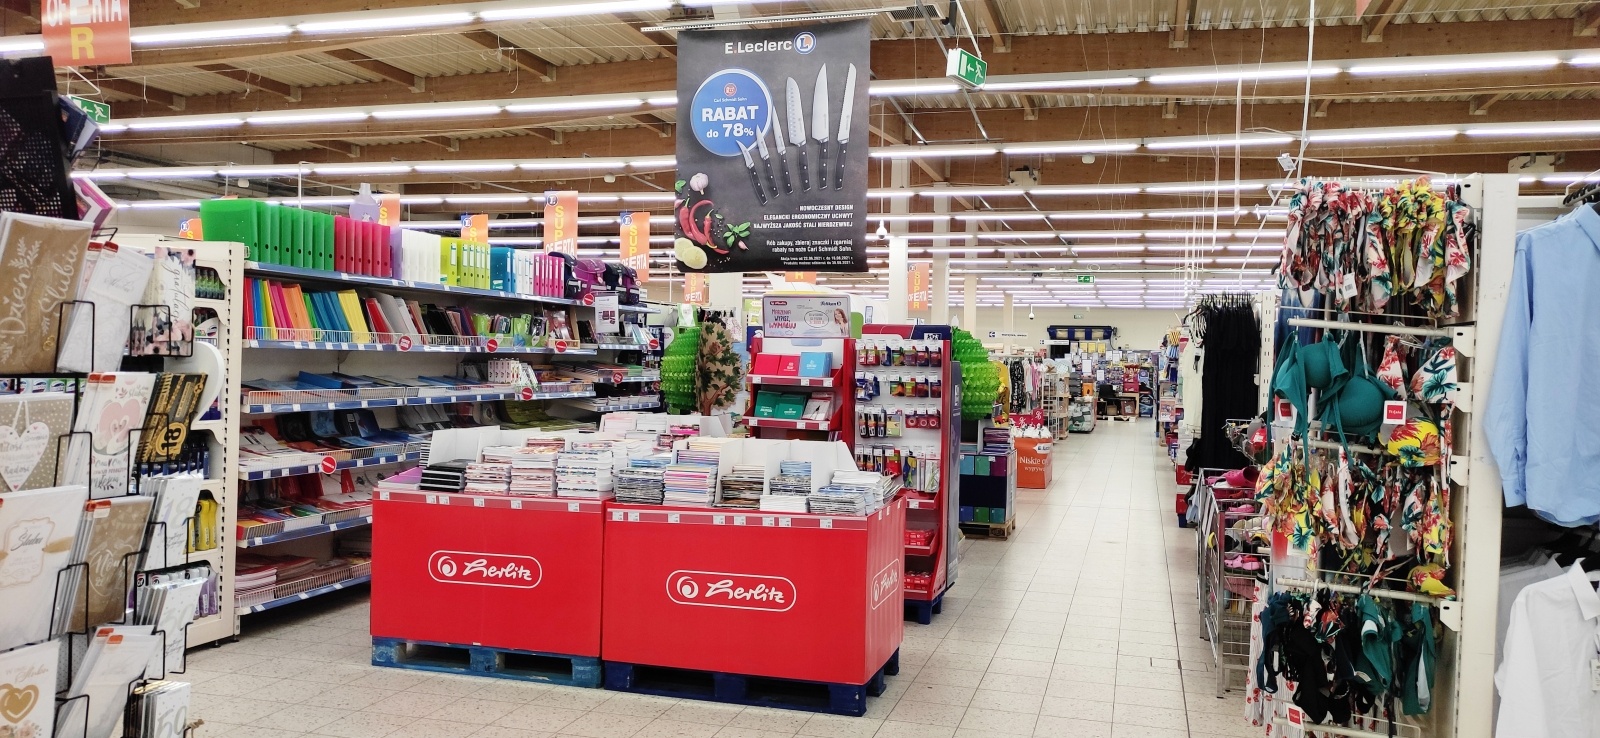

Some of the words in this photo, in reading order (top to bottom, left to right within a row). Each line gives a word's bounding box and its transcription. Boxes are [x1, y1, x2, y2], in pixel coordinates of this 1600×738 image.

[724, 39, 793, 54] E.Leclerc
[702, 105, 759, 122] RABAT
[706, 129, 719, 138] do
[722, 122, 754, 138] 78%
[753, 221, 782, 229] NAJWYŻSZA
[1019, 456, 1041, 465] Niskie
